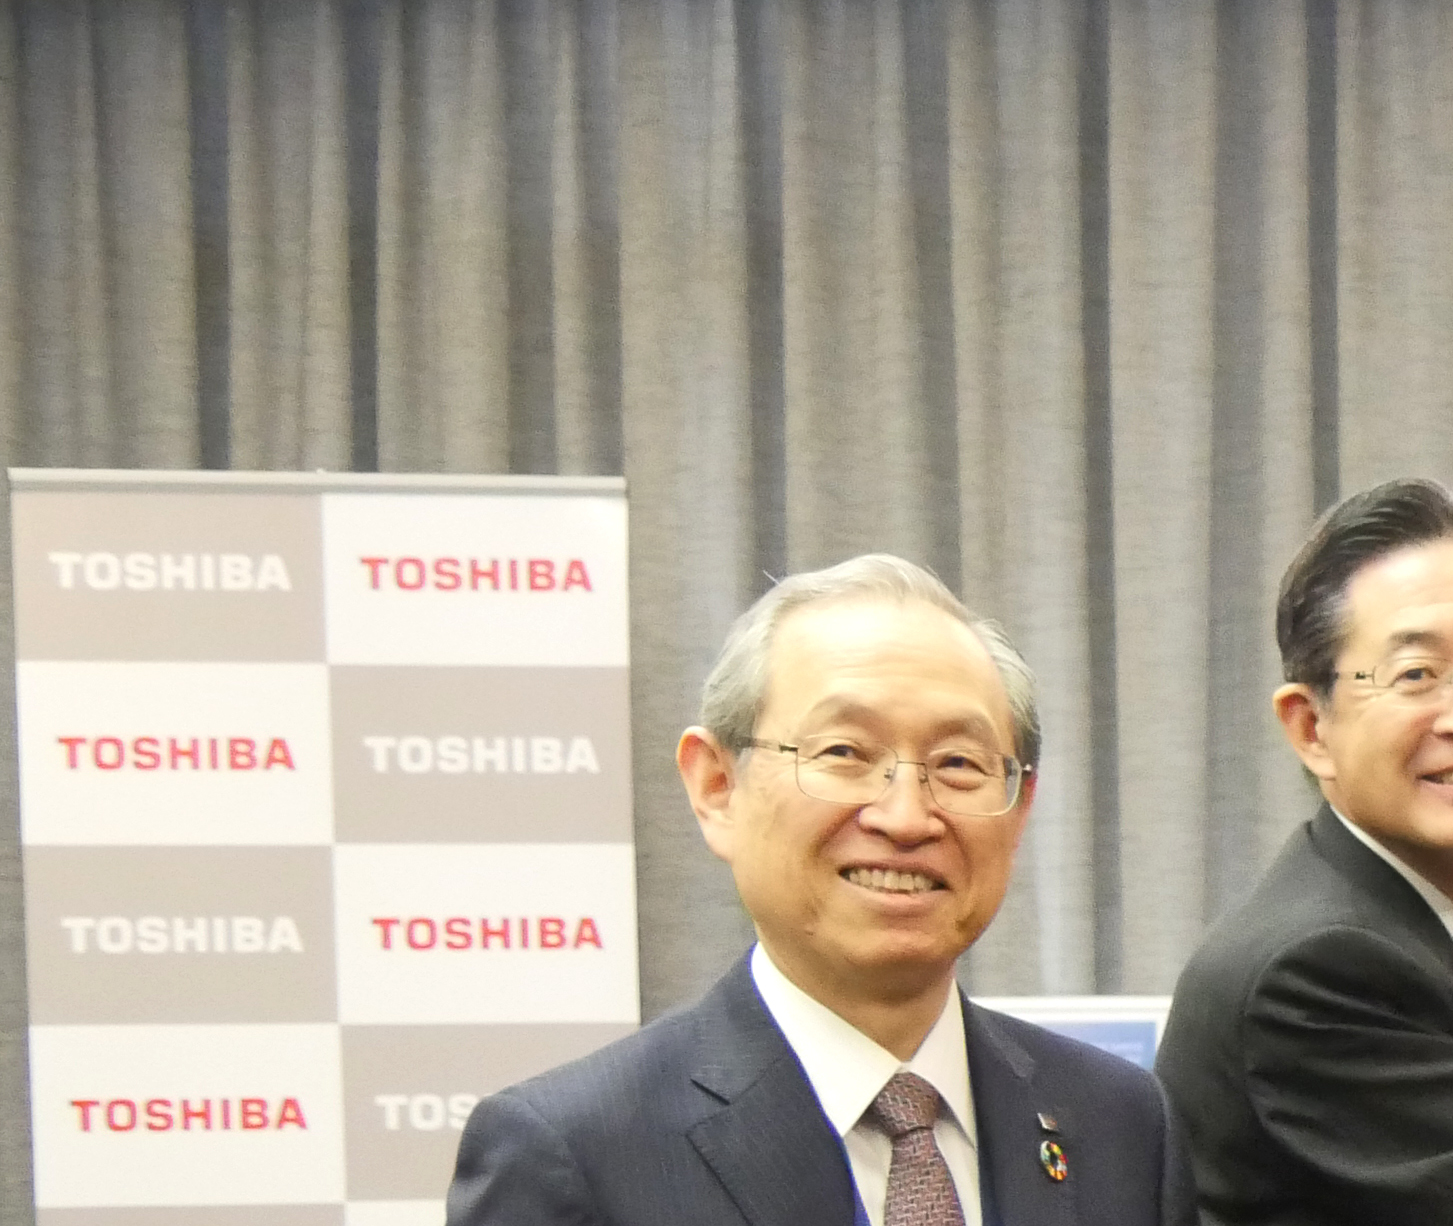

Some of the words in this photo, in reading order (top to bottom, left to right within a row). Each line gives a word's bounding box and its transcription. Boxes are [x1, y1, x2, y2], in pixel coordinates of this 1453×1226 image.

[48, 552, 291, 591] TOSHIBA
[361, 556, 592, 592] TOSHIBA
[57, 736, 295, 772] TOSHIBA
[364, 736, 599, 773] TOSHIBA
[61, 916, 304, 954] TOSHIBA
[373, 917, 603, 951] TOSHIBA
[72, 1097, 307, 1133] TOSHIBA
[376, 1093, 488, 1131] TOS
